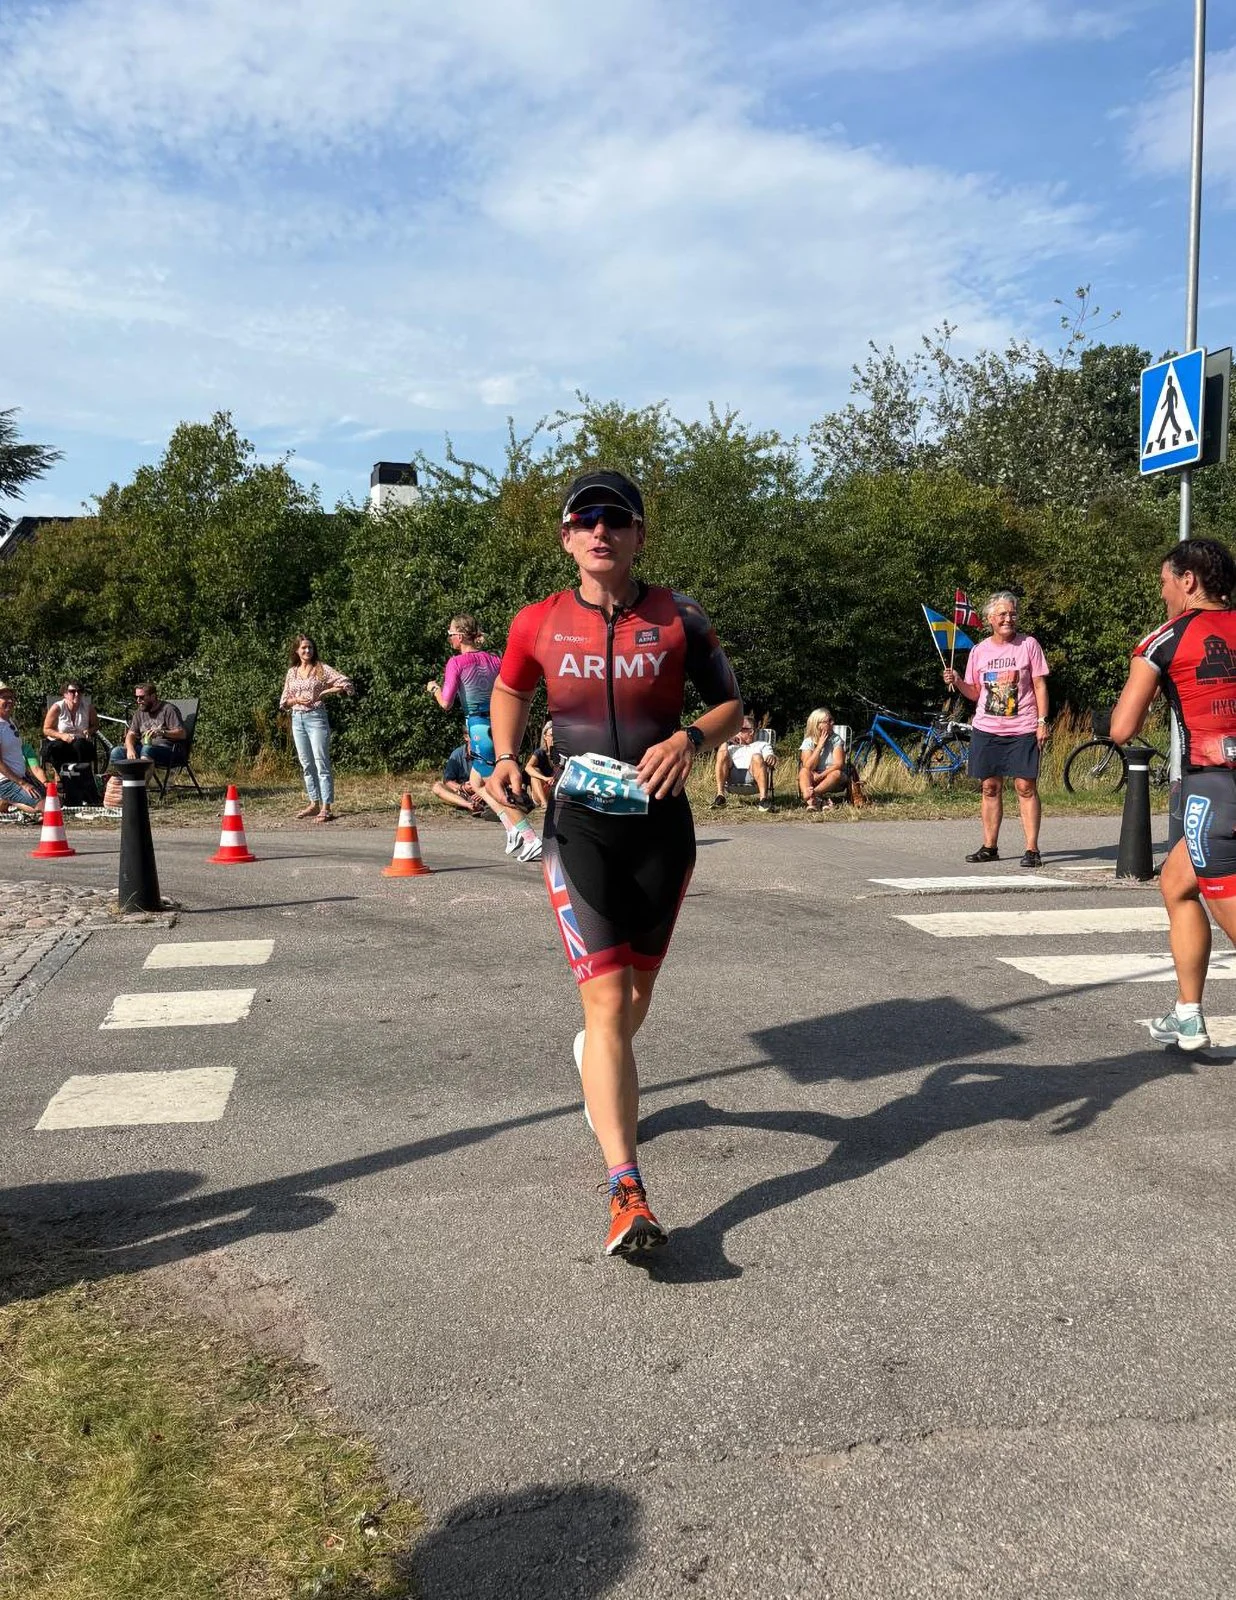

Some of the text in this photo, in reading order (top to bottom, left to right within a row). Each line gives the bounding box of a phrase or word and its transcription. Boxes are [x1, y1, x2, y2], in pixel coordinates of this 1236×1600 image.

[558, 651, 667, 680] ARMY
[987, 657, 1017, 670] HEDDA
[1186, 801, 1205, 862] LECOR
